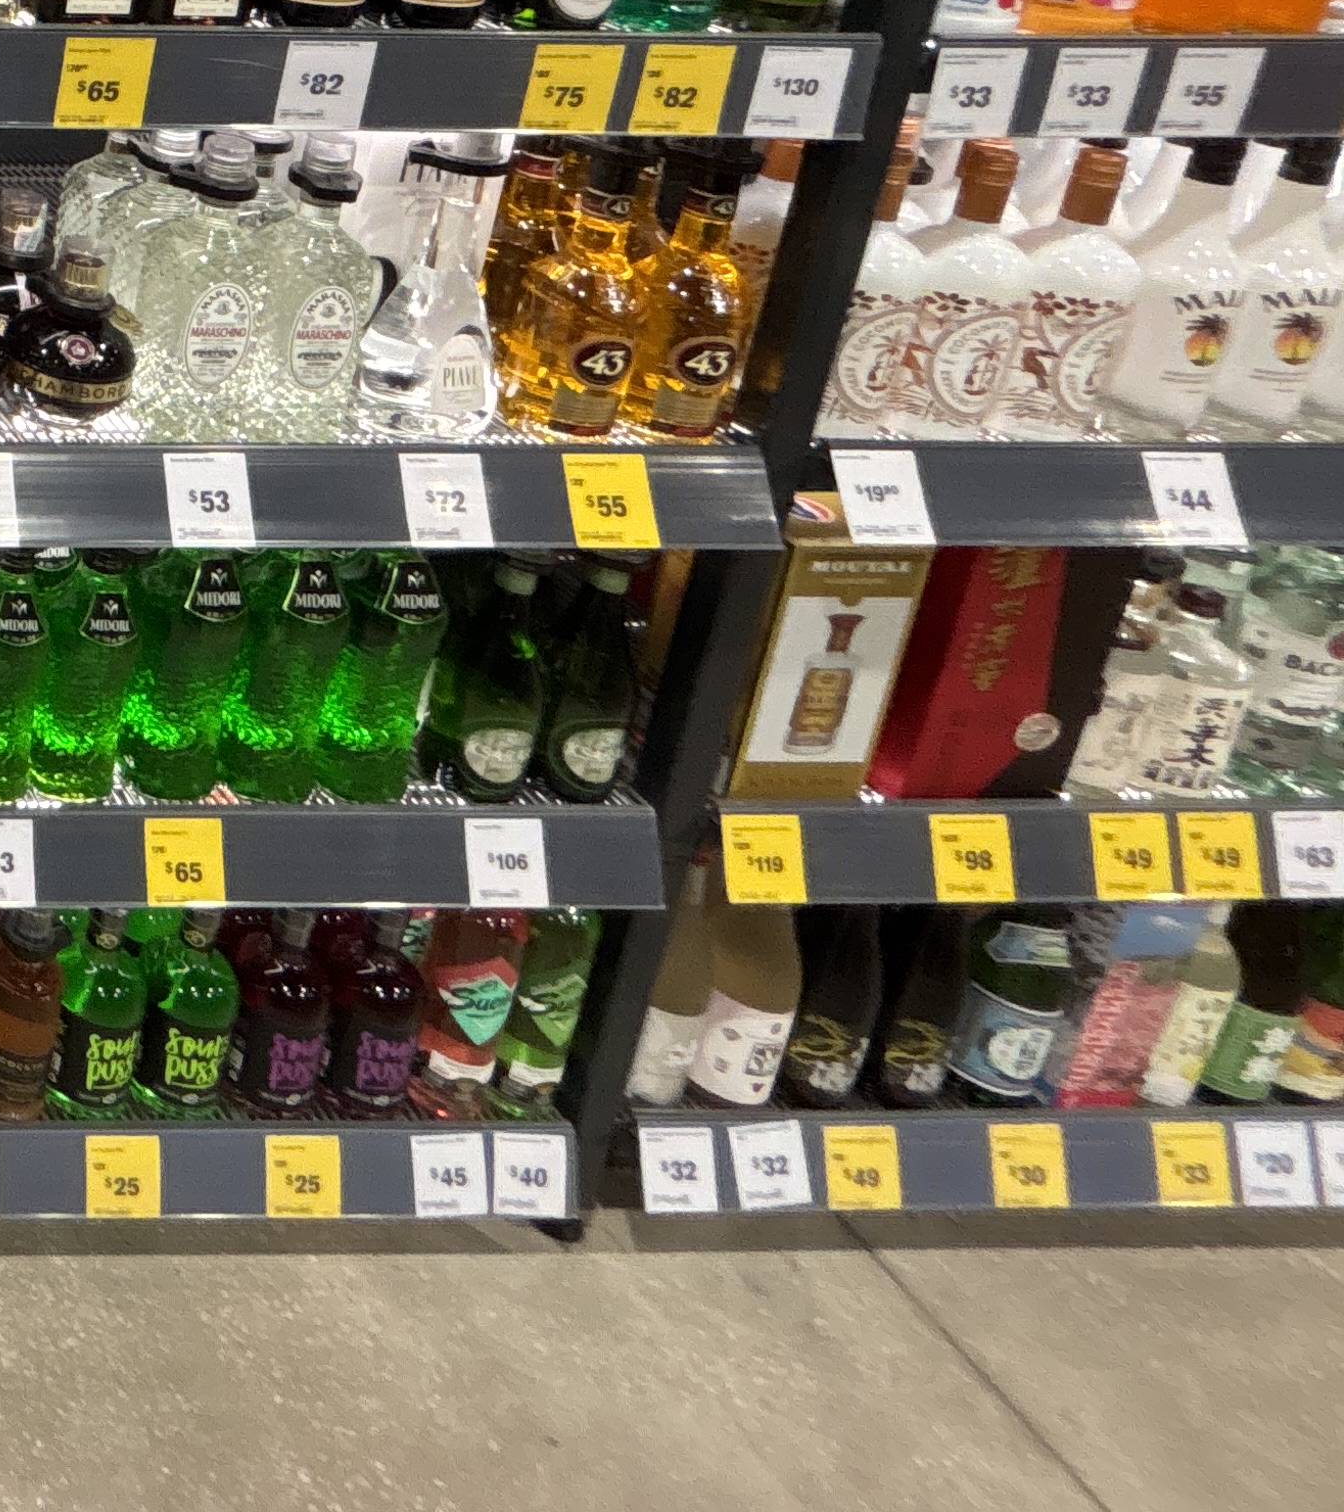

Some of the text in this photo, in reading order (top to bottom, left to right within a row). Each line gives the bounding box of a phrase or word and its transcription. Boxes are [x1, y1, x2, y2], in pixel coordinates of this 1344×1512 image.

[77, 81, 119, 102] $65
[301, 73, 344, 95] $82
[774, 78, 819, 96] $130
[544, 86, 585, 107] $75
[655, 87, 697, 108] $82
[306, 292, 350, 315] MARASKA
[190, 327, 247, 338] MARASCHINO
[296, 329, 352, 341] MARASCHINO
[581, 349, 627, 377] 43
[684, 349, 731, 377] 43
[189, 490, 230, 512] $53
[0, 618, 39, 632] MIDORI
[90, 617, 131, 633] MIDORI
[488, 853, 528, 870] $106
[105, 1177, 139, 1196] $25
[286, 1174, 320, 1193] $25
